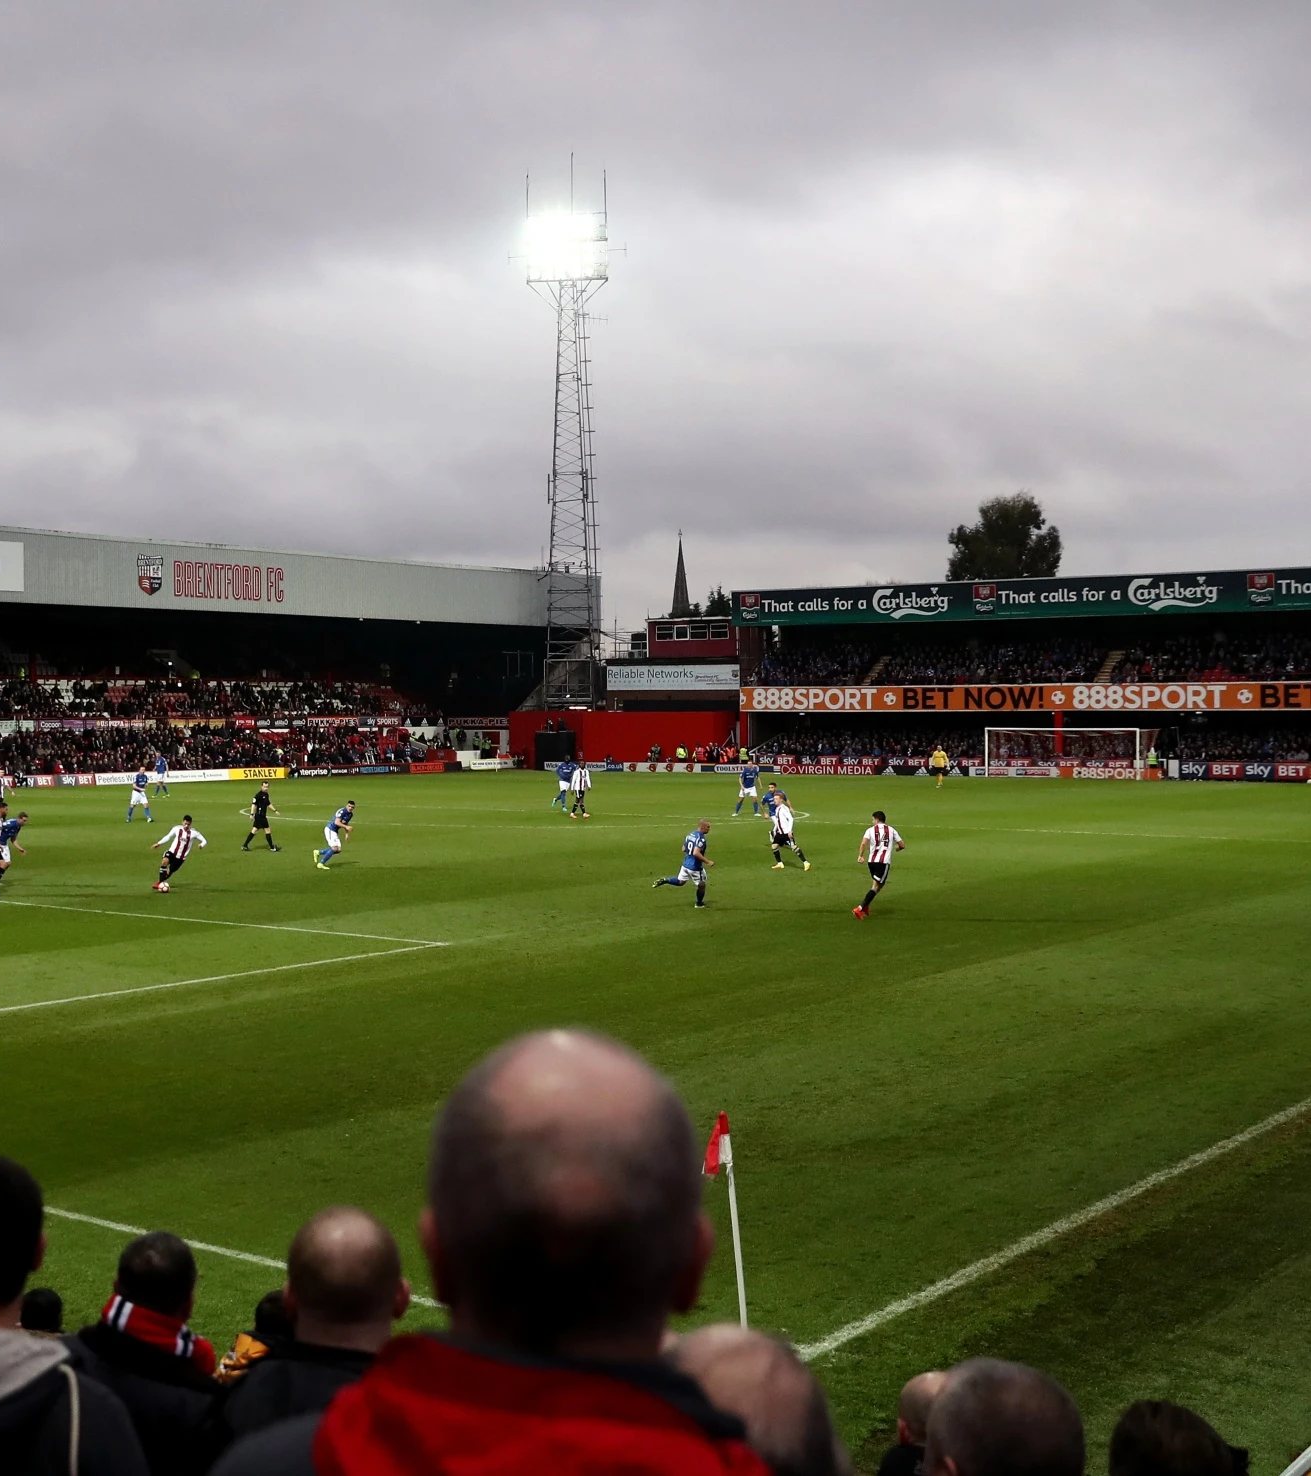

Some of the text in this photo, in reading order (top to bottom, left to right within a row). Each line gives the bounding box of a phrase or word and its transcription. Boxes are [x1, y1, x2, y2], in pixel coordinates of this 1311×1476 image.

[174, 560, 283, 602] BRENTFORD FC
[1277, 579, 1311, 595] Tha
[998, 587, 1121, 605] That calls for a
[1128, 577, 1219, 611] Carlsberg
[762, 596, 866, 613] That calls for a
[872, 587, 949, 619] Carlsberg
[608, 668, 694, 679] Reliable Networks
[753, 688, 877, 710] 888SPORT
[903, 687, 954, 709] BET
[964, 686, 1044, 709] NOW!
[1073, 685, 1227, 709] 888SPORT
[377, 717, 399, 726] SPORTS
[759, 756, 774, 766] sky
[777, 756, 795, 765] BET
[821, 756, 837, 765] BET
[843, 756, 858, 766] sky
[863, 757, 879, 765] BET
[889, 757, 904, 766] sky
[908, 757, 926, 766] BET
[244, 768, 278, 778] STANLEY
[299, 768, 328, 777] nterprise
[798, 765, 873, 775] VIRGIN MEDIA
[1181, 764, 1305, 777] sky BET sky BET
[38, 776, 52, 786] BET
[62, 774, 93, 786] sky BET
[98, 774, 125, 784] Peerless
[687, 840, 694, 855] 9
